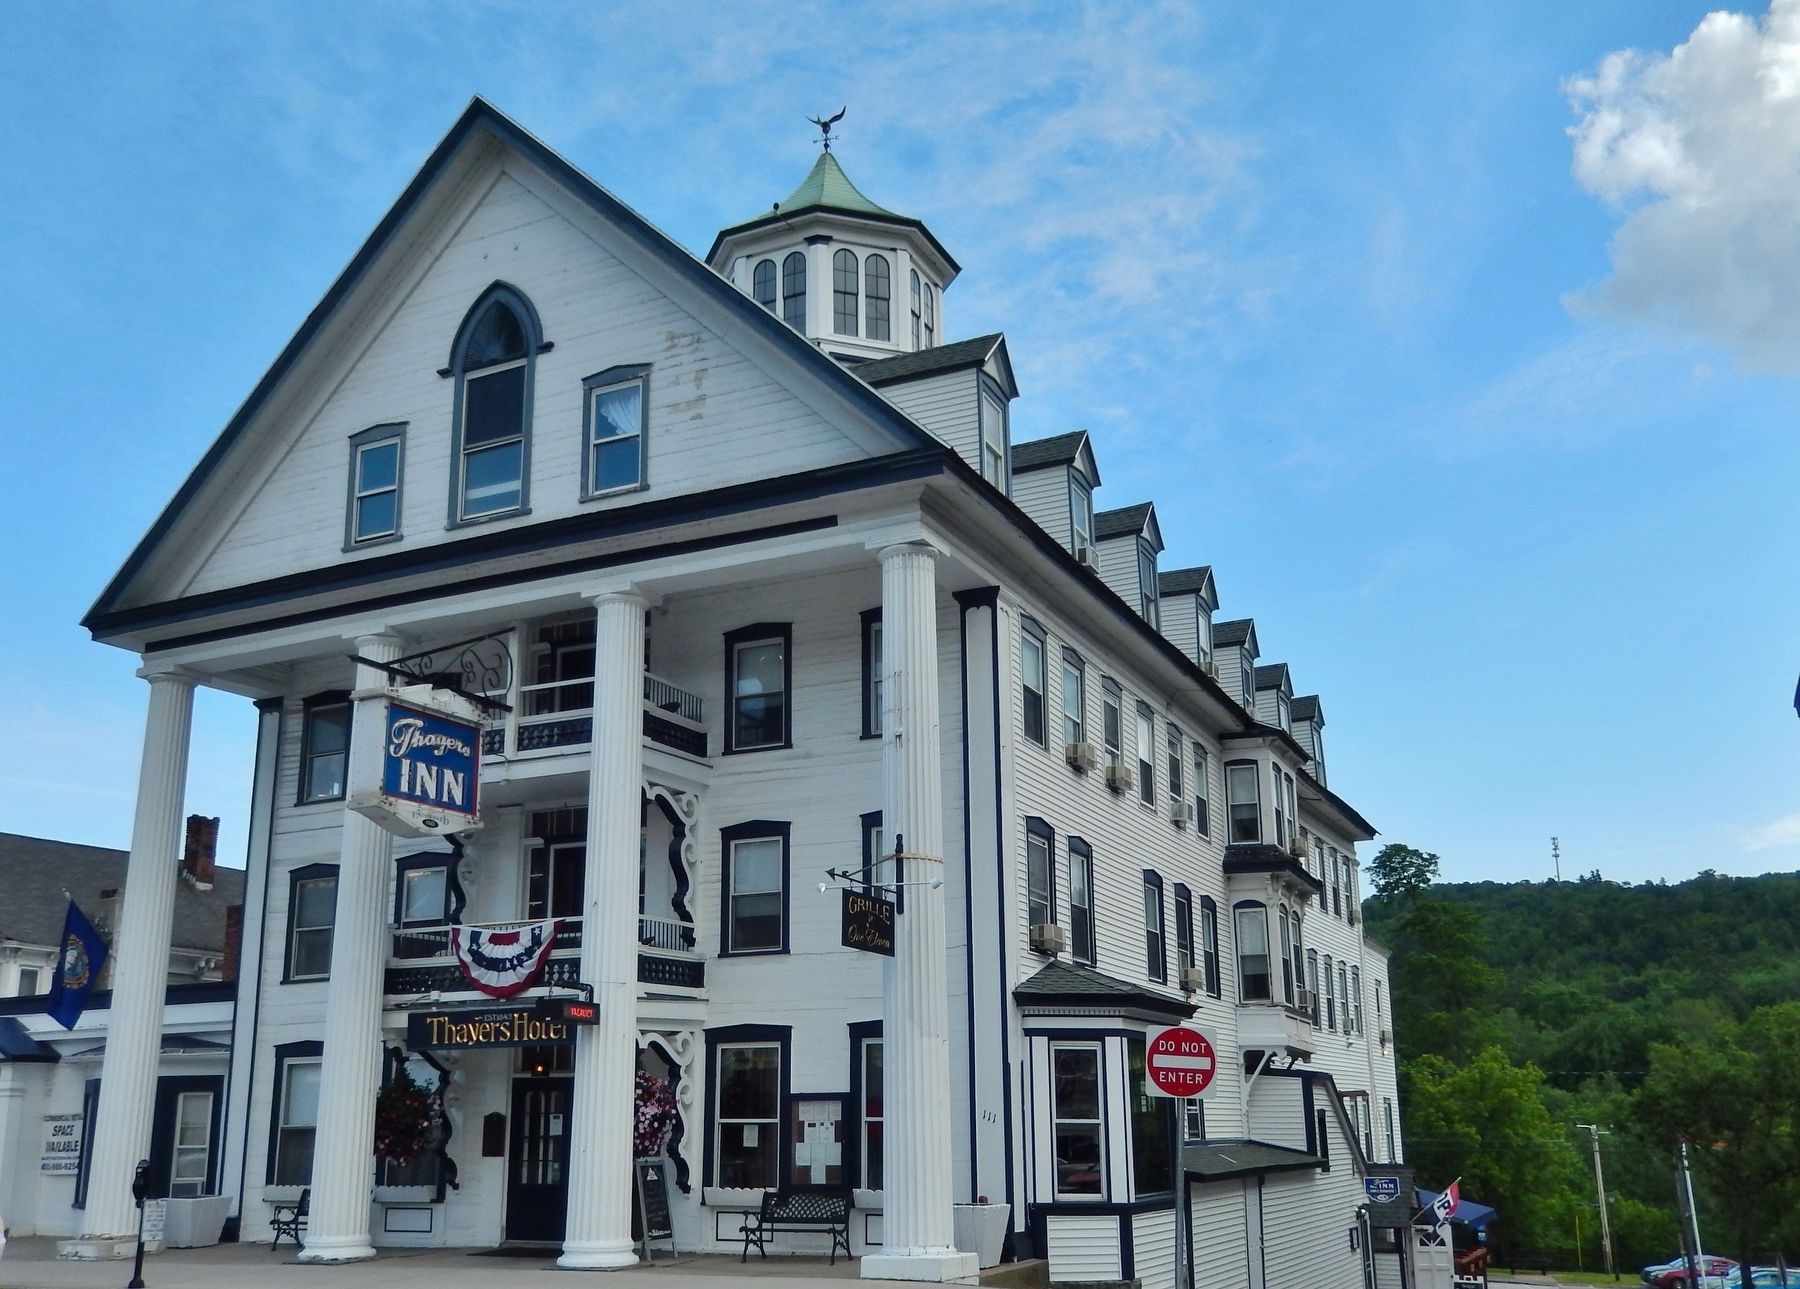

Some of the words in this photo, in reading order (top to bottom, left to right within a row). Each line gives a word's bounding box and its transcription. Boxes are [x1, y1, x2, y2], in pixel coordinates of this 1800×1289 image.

[390, 718, 471, 757] Thayers
[400, 758, 464, 806] INN
[848, 896, 890, 924] GRILLE
[427, 1015, 510, 1046] Thayers
[1159, 1040, 1175, 1052] DO
[1181, 1042, 1206, 1054] NOT
[1160, 1071, 1203, 1085] ENTER
[52, 1124, 75, 1137] SPACE
